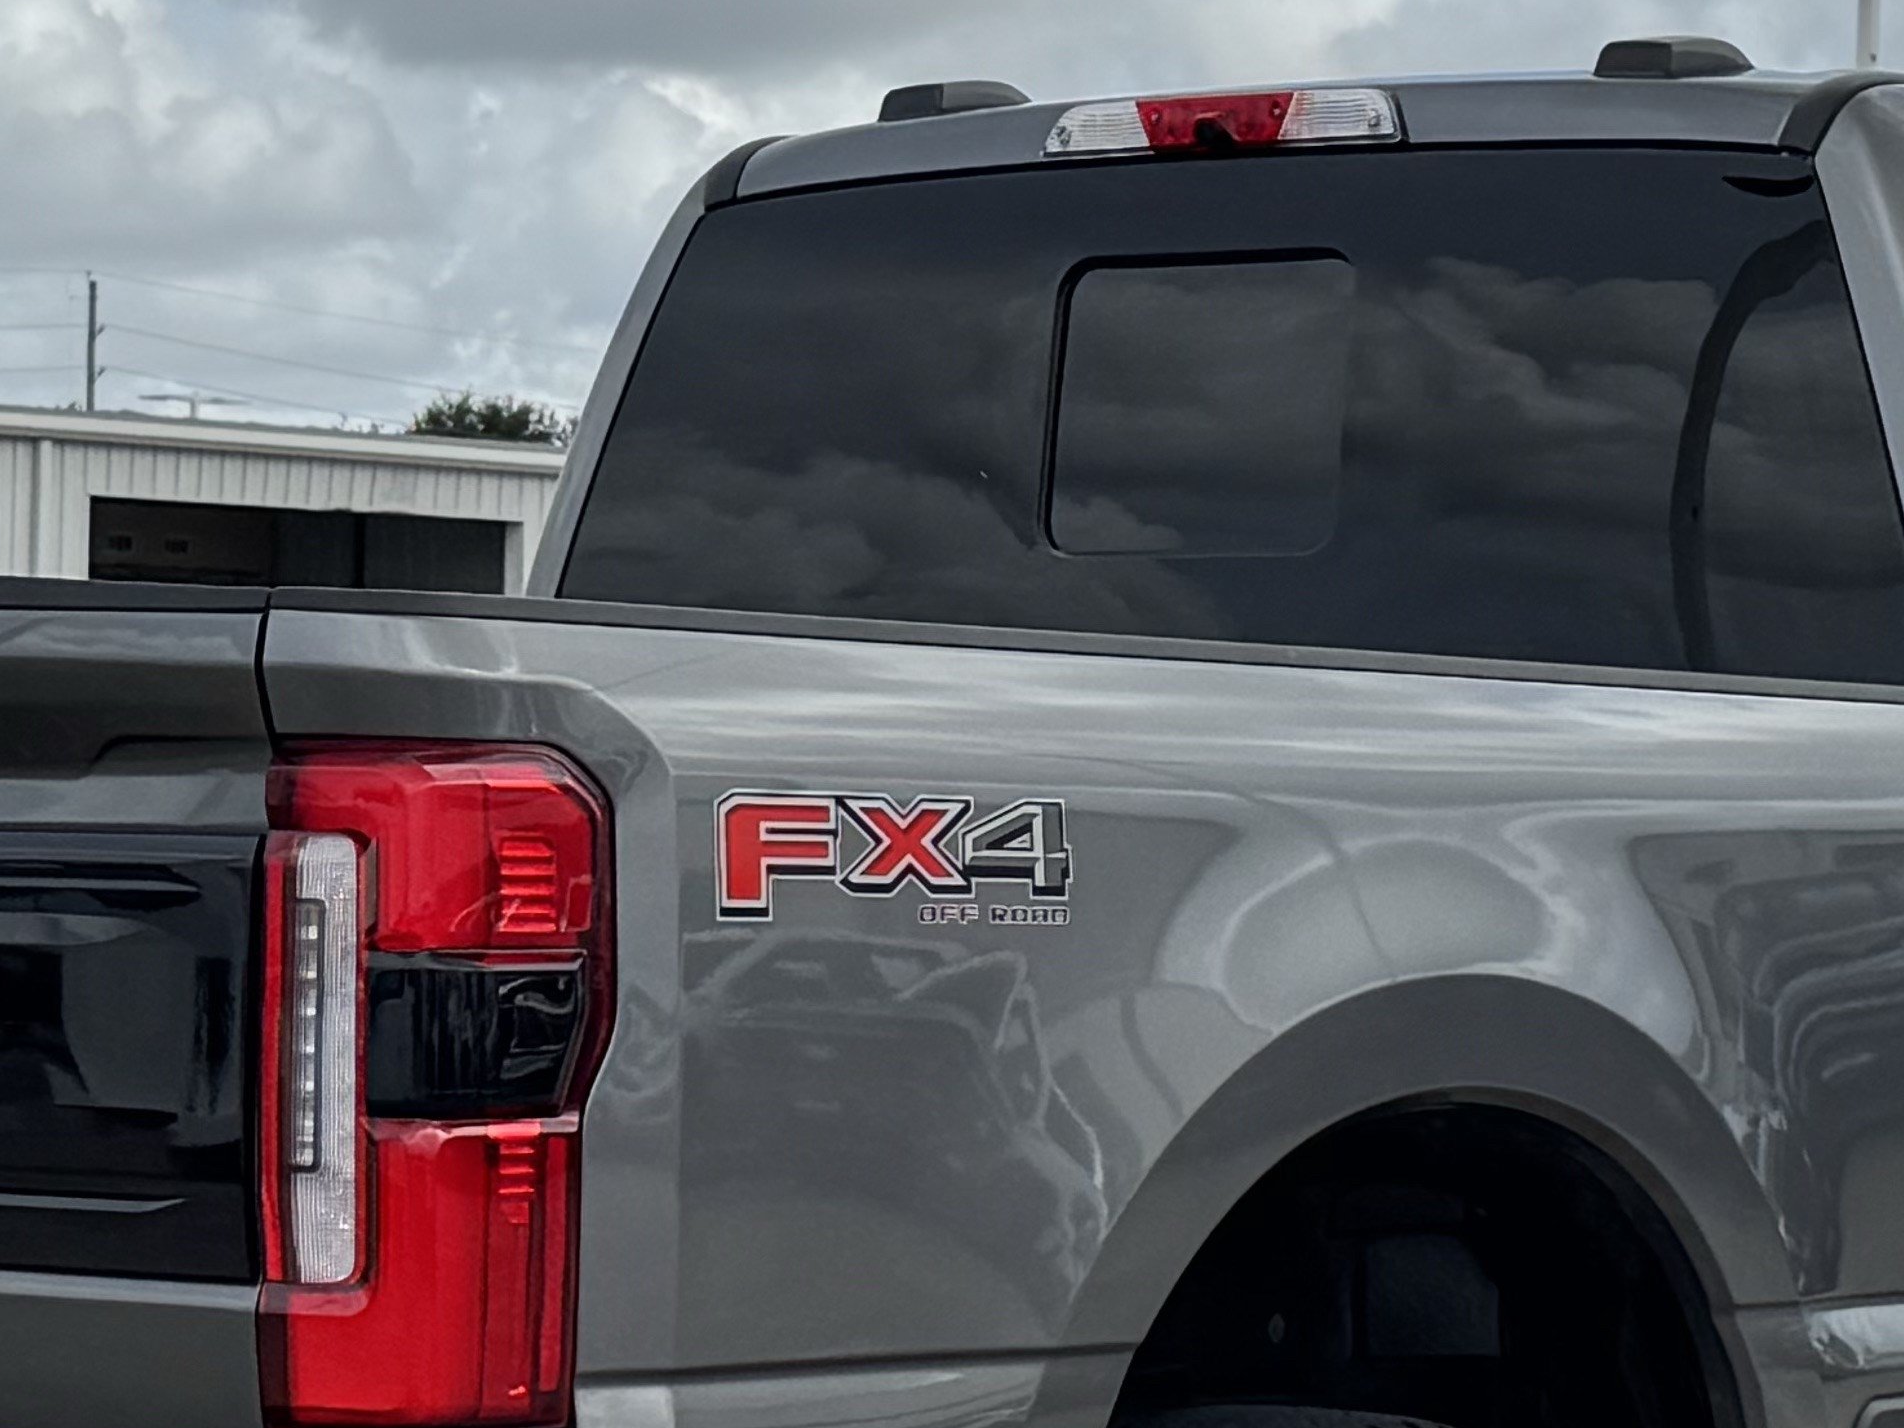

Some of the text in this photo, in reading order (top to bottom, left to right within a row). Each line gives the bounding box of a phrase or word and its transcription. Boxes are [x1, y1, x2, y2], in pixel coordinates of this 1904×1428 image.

[714, 788, 1073, 921] FX4
[918, 904, 1071, 926] OFF ROAD
